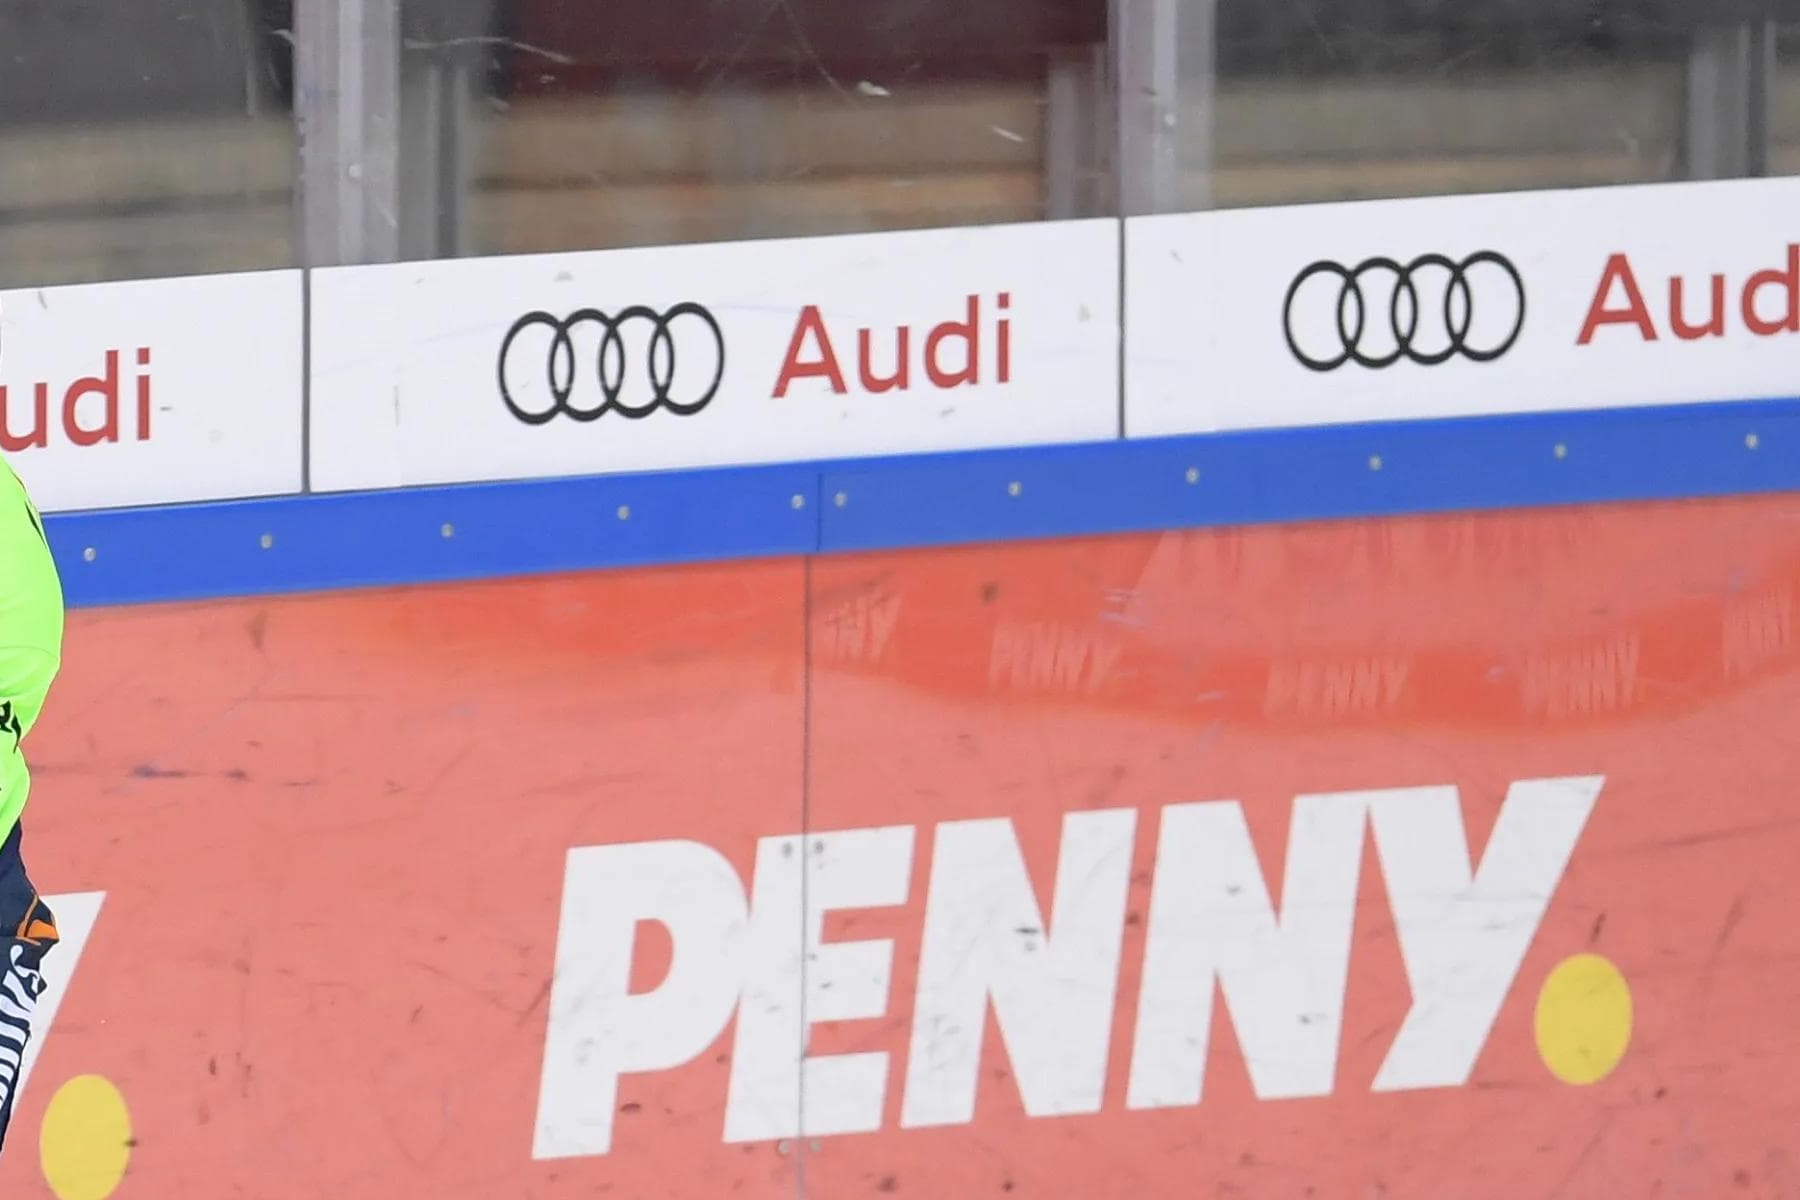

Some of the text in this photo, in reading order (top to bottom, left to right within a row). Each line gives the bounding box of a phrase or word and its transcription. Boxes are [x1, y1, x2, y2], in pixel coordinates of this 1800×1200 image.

[772, 294, 1011, 397] Audi
[1578, 244, 1800, 345] Aud
[531, 774, 1606, 1161] PENNY
